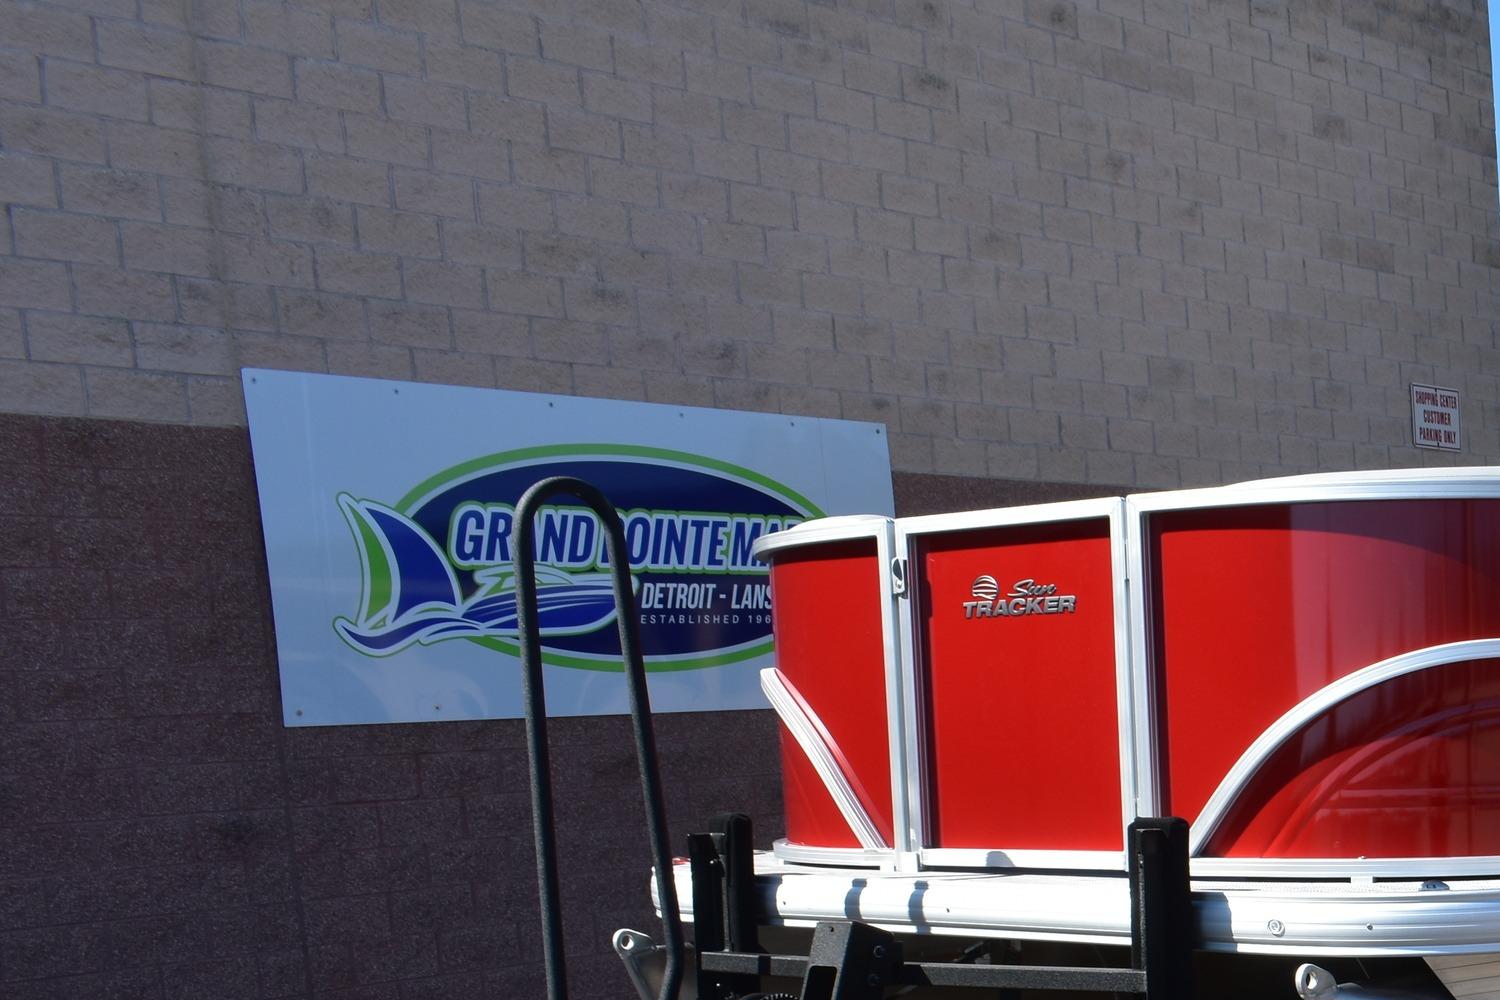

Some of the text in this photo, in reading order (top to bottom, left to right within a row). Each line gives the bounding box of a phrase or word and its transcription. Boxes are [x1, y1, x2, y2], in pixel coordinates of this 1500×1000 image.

[1415, 390, 1457, 410] SHOPPING CENTER
[1423, 409, 1451, 426] CUSTOMER
[1419, 427, 1457, 444] PARKING ONLY
[454, 507, 597, 565] GRND
[641, 582, 716, 610] DETROIT
[1007, 578, 1057, 598] Sun
[962, 595, 1076, 619] TRACKER
[640, 614, 740, 624] ESTABLISHED
